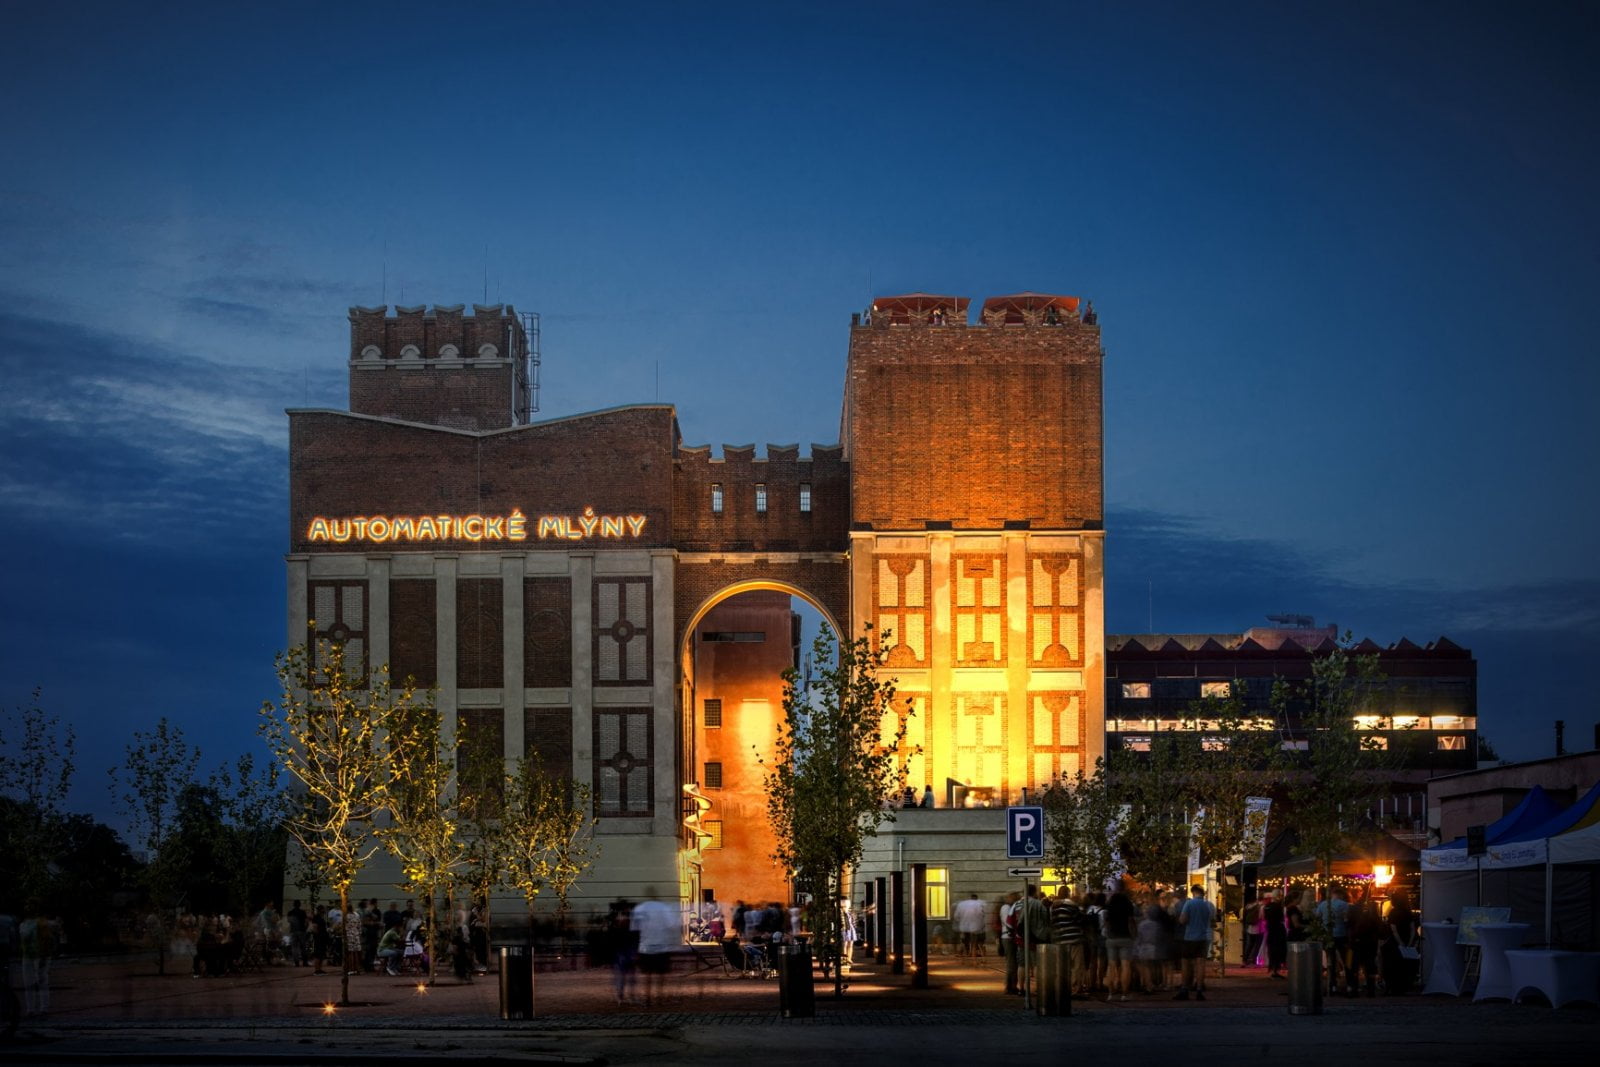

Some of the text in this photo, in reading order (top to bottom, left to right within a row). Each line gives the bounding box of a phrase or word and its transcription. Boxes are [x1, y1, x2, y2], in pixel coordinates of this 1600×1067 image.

[309, 507, 646, 540] AUTOMATICKÉ MLÝNY
[1015, 813, 1035, 842] P
